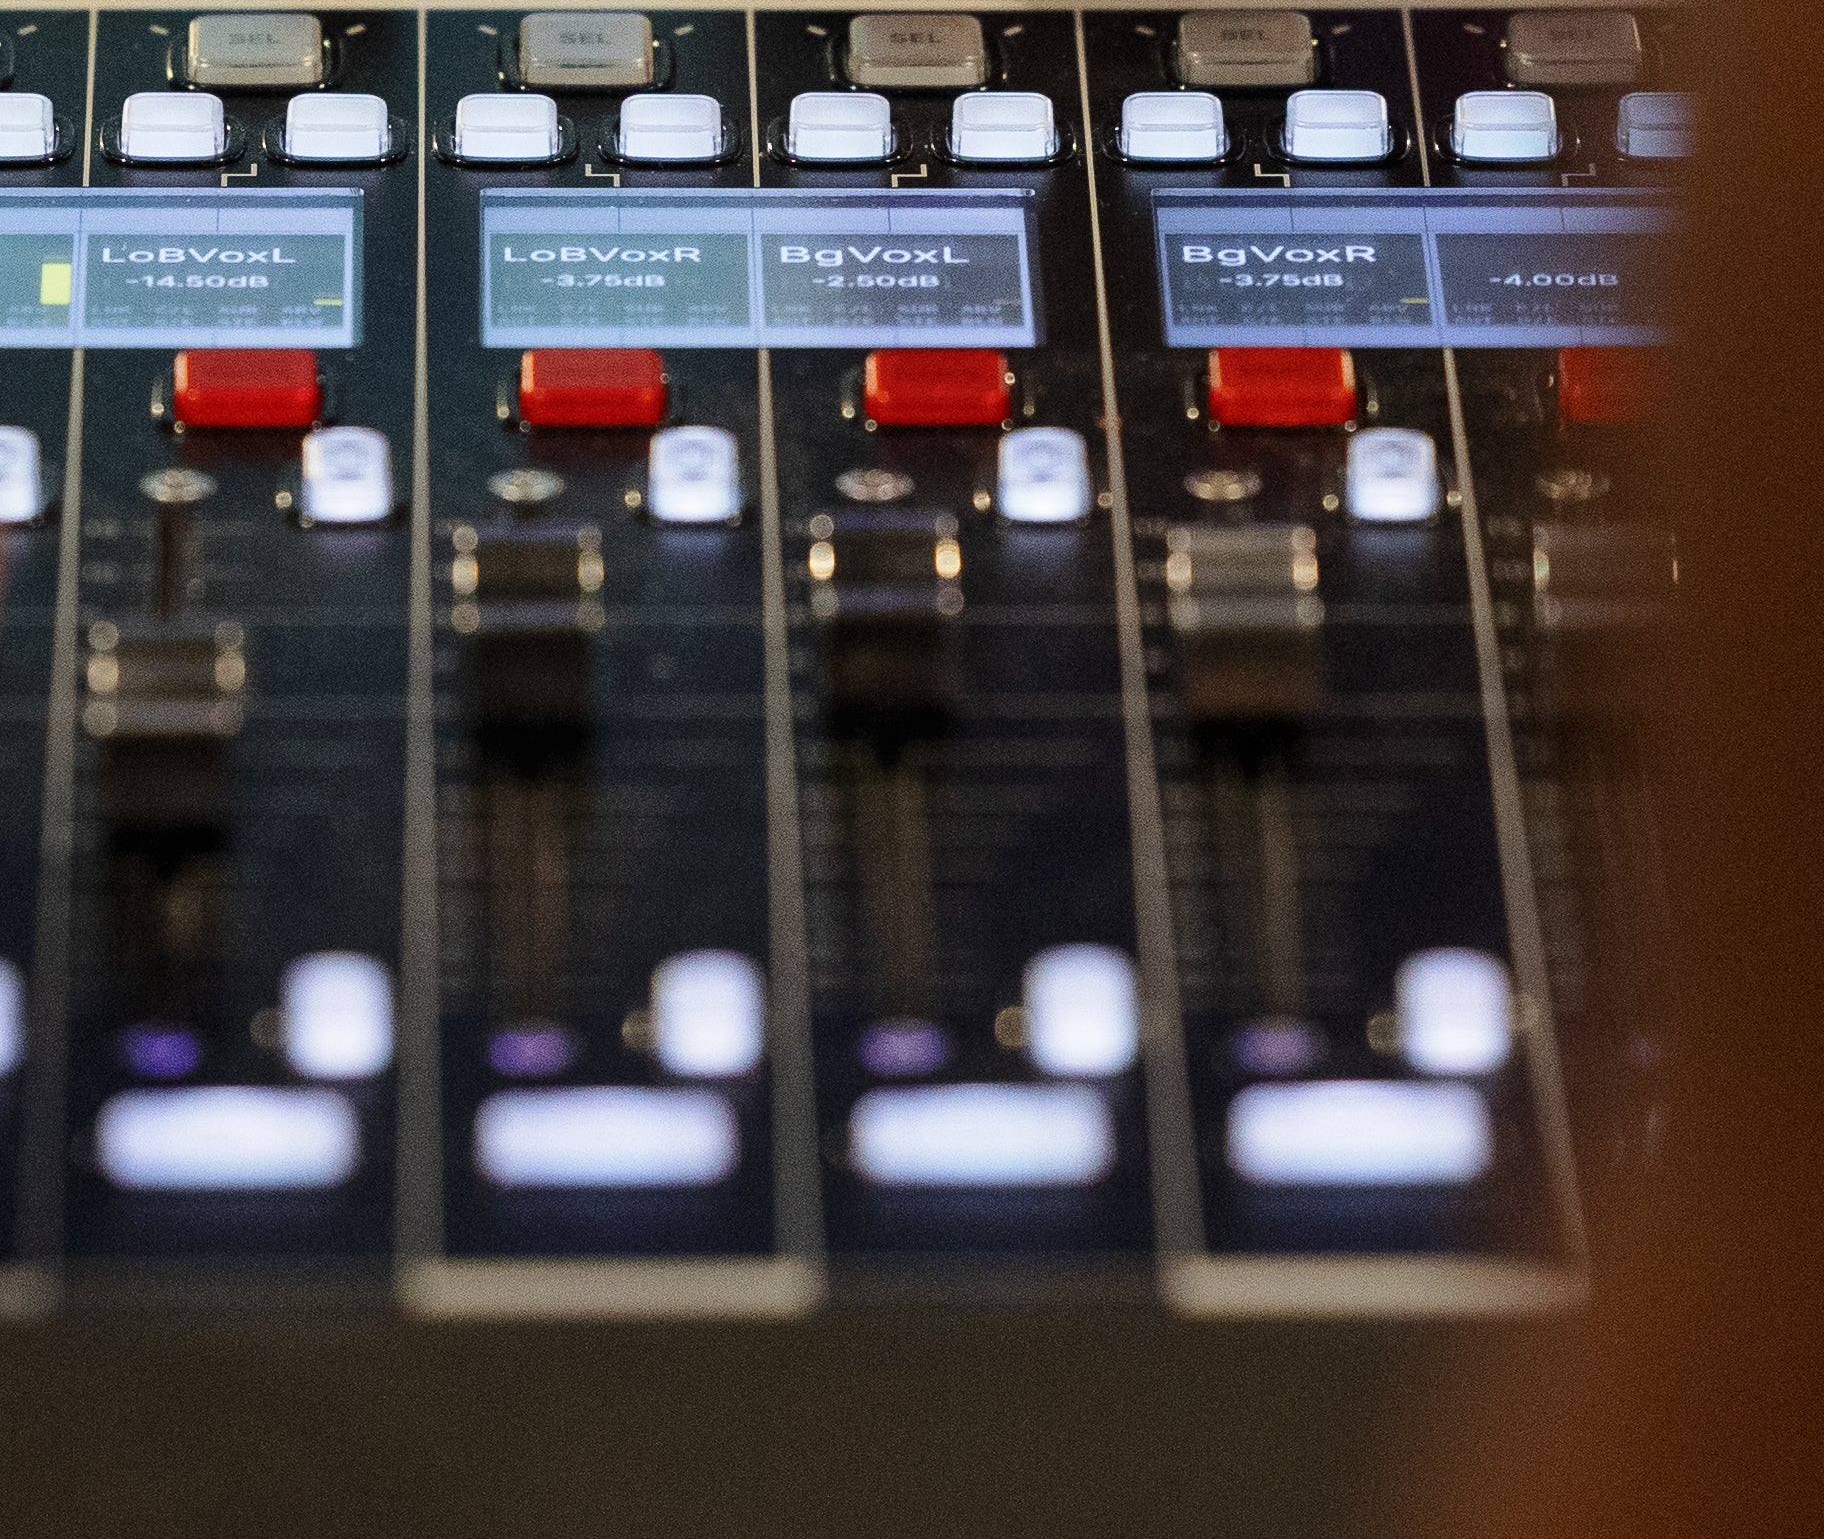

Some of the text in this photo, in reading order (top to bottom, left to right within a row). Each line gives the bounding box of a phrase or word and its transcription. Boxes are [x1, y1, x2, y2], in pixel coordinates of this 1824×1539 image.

[559, 32, 612, 45] SEL
[889, 32, 942, 44] SEL
[101, 247, 297, 264] LoBVoxL
[503, 246, 702, 263] LoBVoxR
[779, 245, 970, 268] BgVoxL
[1181, 244, 1377, 267] BgVoxR
[126, 274, 270, 289] -14.50dB
[542, 273, 666, 288] -3.75dB
[811, 274, 941, 288] -2.50dB
[1219, 273, 1345, 287] -3.75dB
[1488, 272, 1619, 287] -4.00dB
